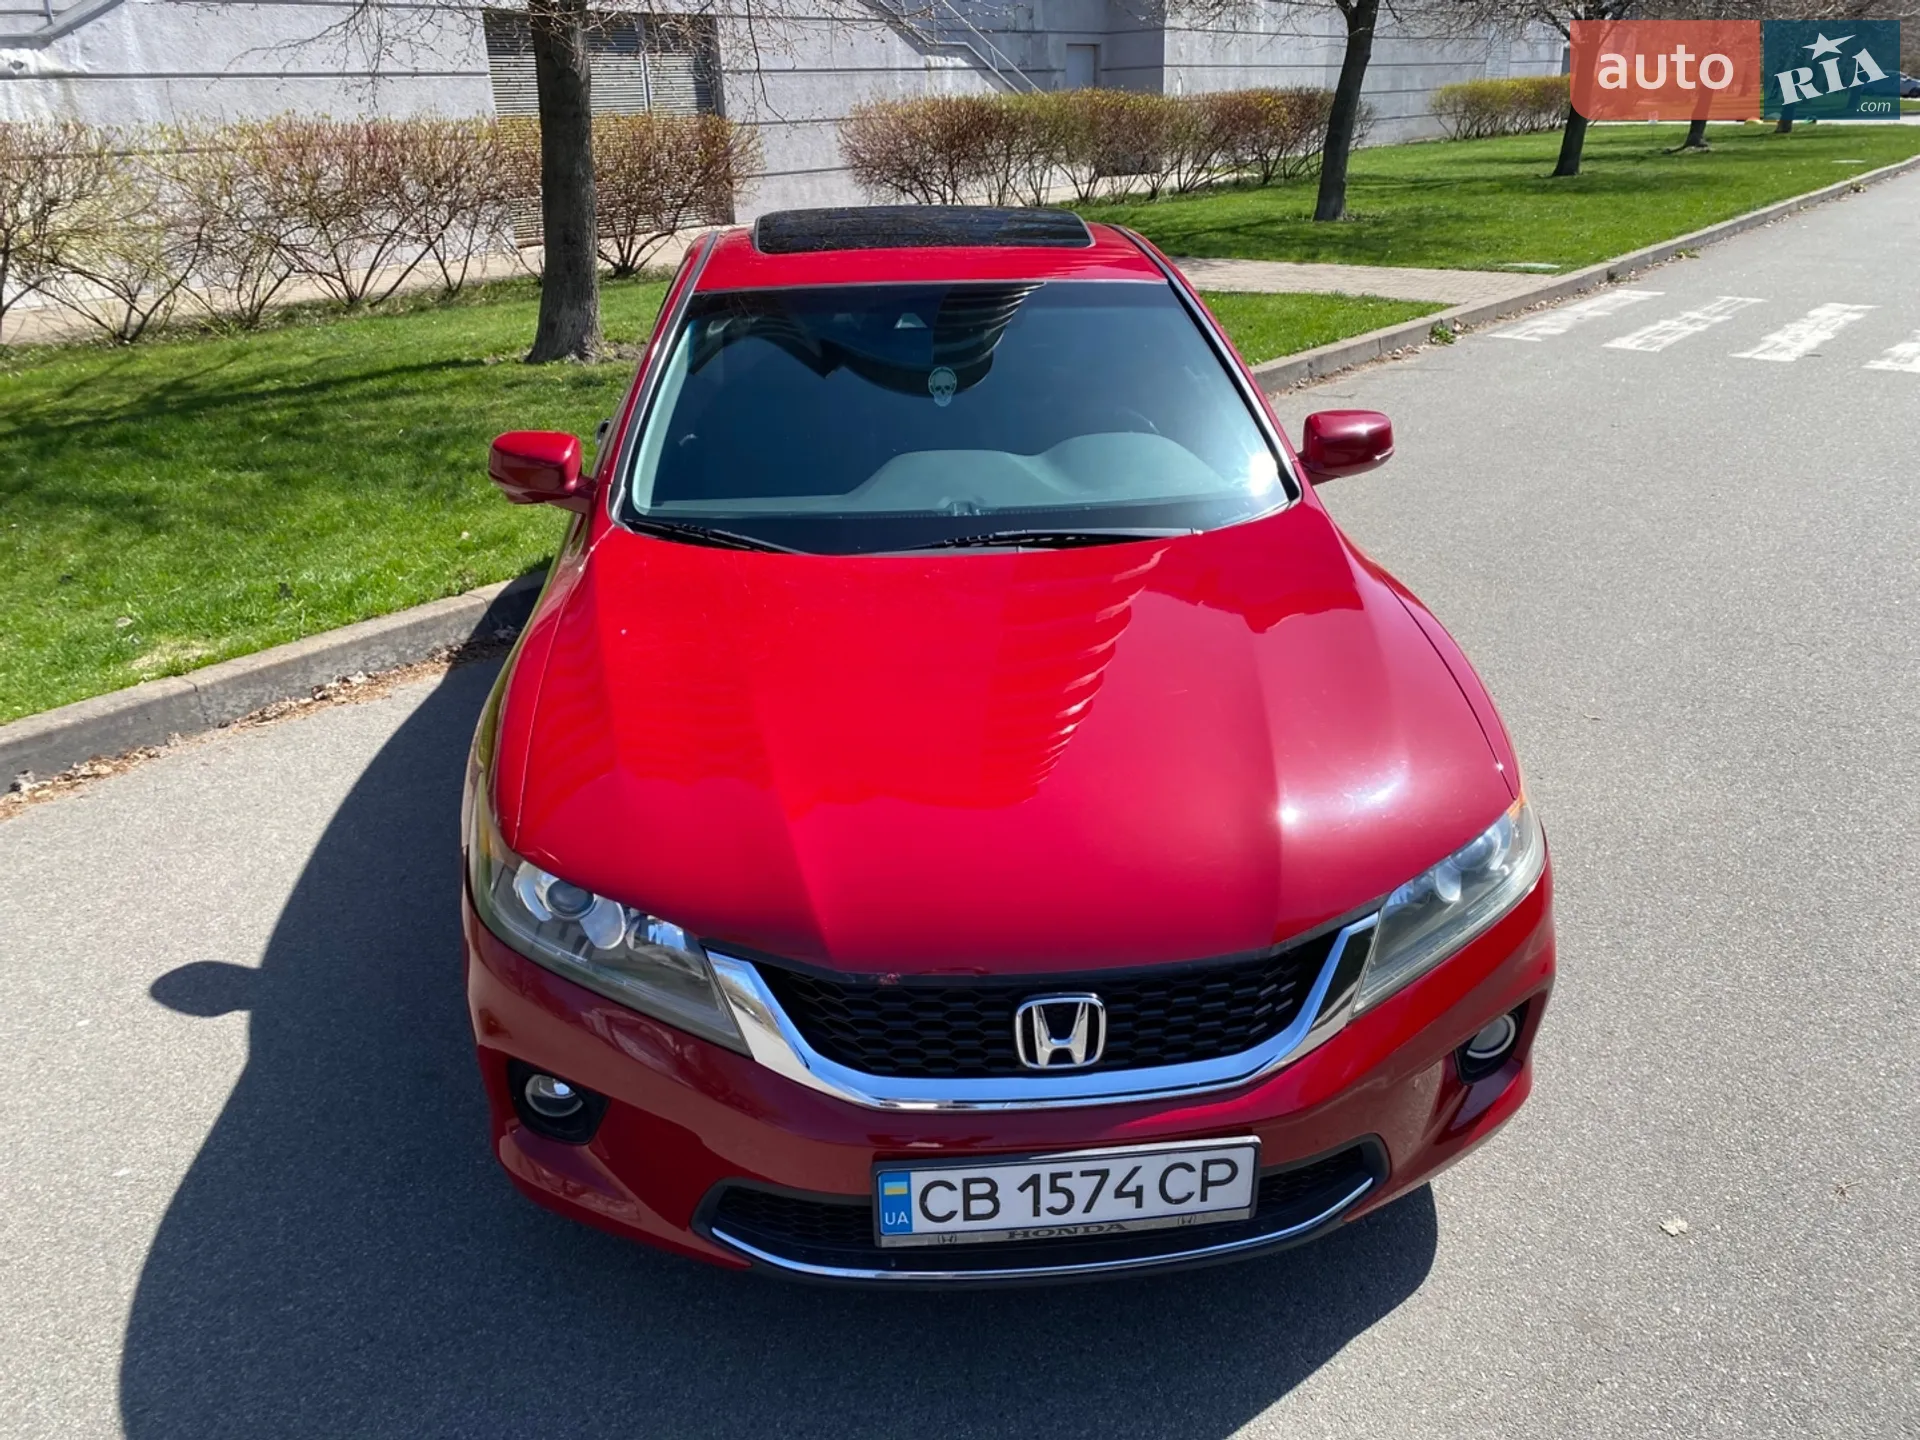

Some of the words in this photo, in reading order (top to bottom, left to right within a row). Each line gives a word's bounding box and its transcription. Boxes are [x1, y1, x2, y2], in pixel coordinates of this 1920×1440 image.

[918, 1177, 1001, 1223] CB
[1017, 1166, 1143, 1218] 1574
[1158, 1157, 1239, 1205] CP
[885, 1211, 909, 1225] UA
[1007, 1223, 1128, 1240] HONDA
